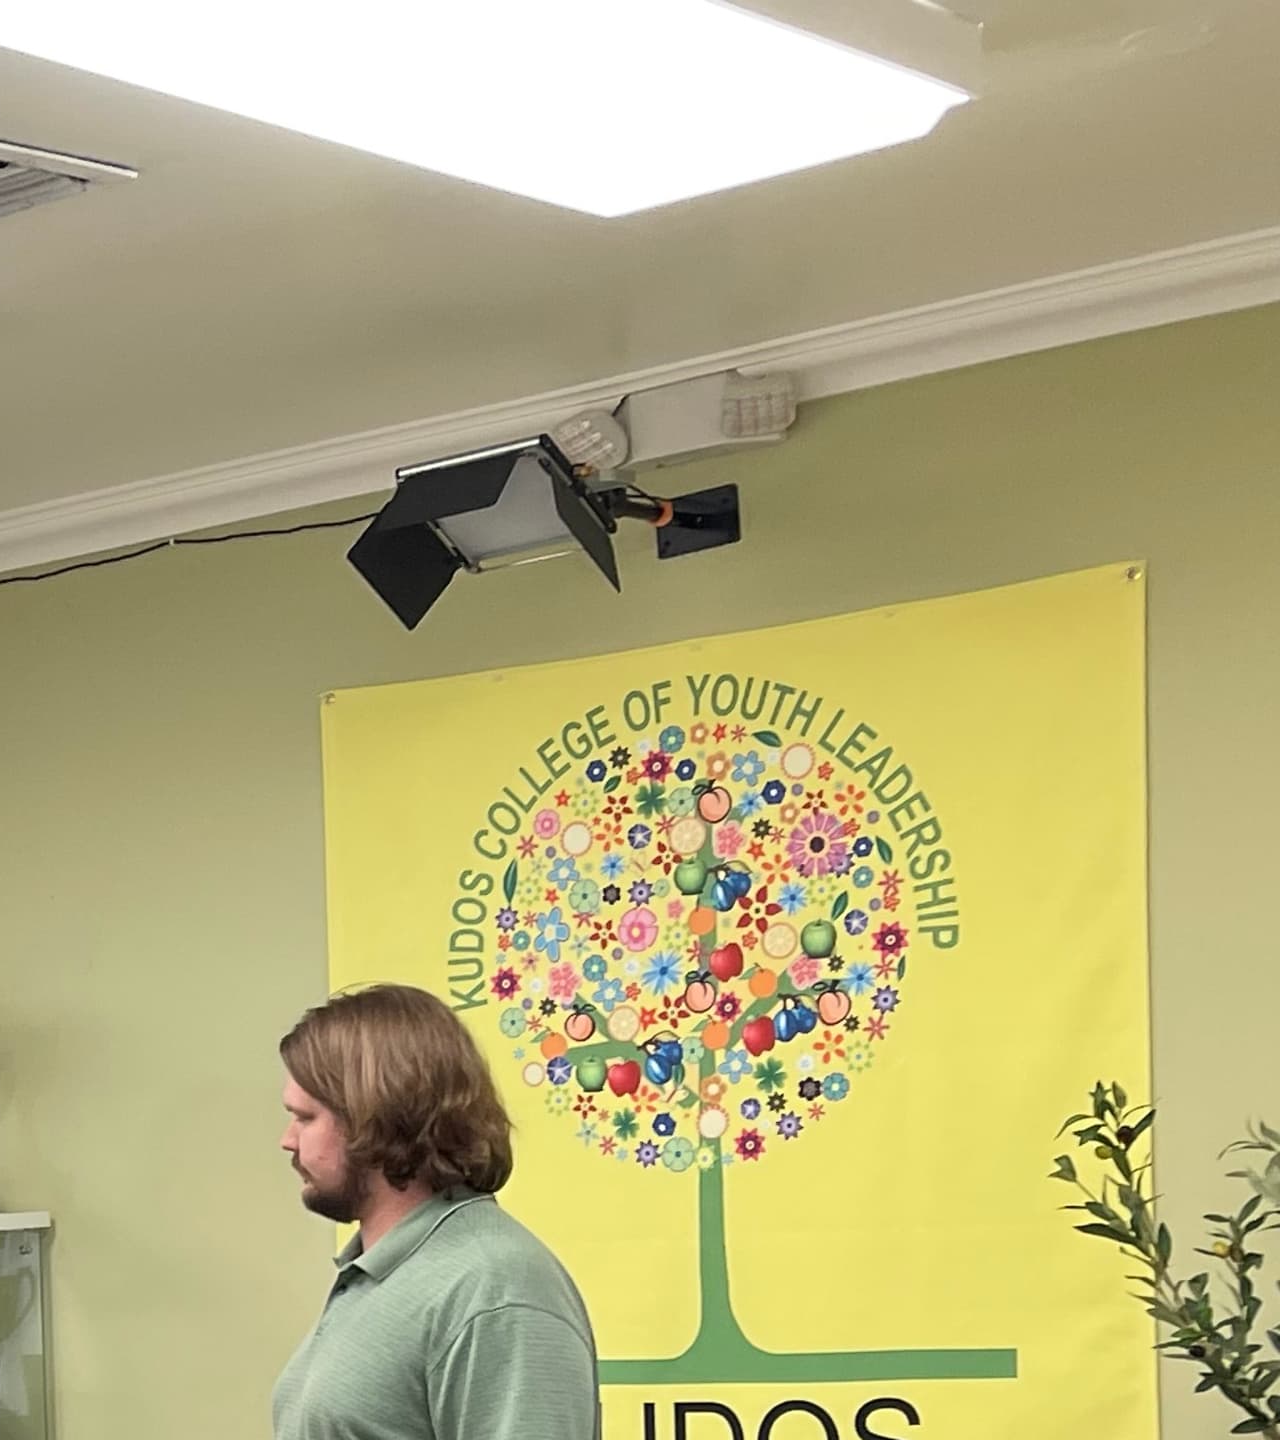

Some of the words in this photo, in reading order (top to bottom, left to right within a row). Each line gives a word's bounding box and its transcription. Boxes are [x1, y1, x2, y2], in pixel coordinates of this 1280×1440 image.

[448, 869, 495, 1012] KUDOS
[473, 704, 617, 860] COLLEGE
[622, 680, 672, 731] OF
[685, 673, 824, 737] YOUTH
[817, 708, 960, 950] LEADERSHIP
